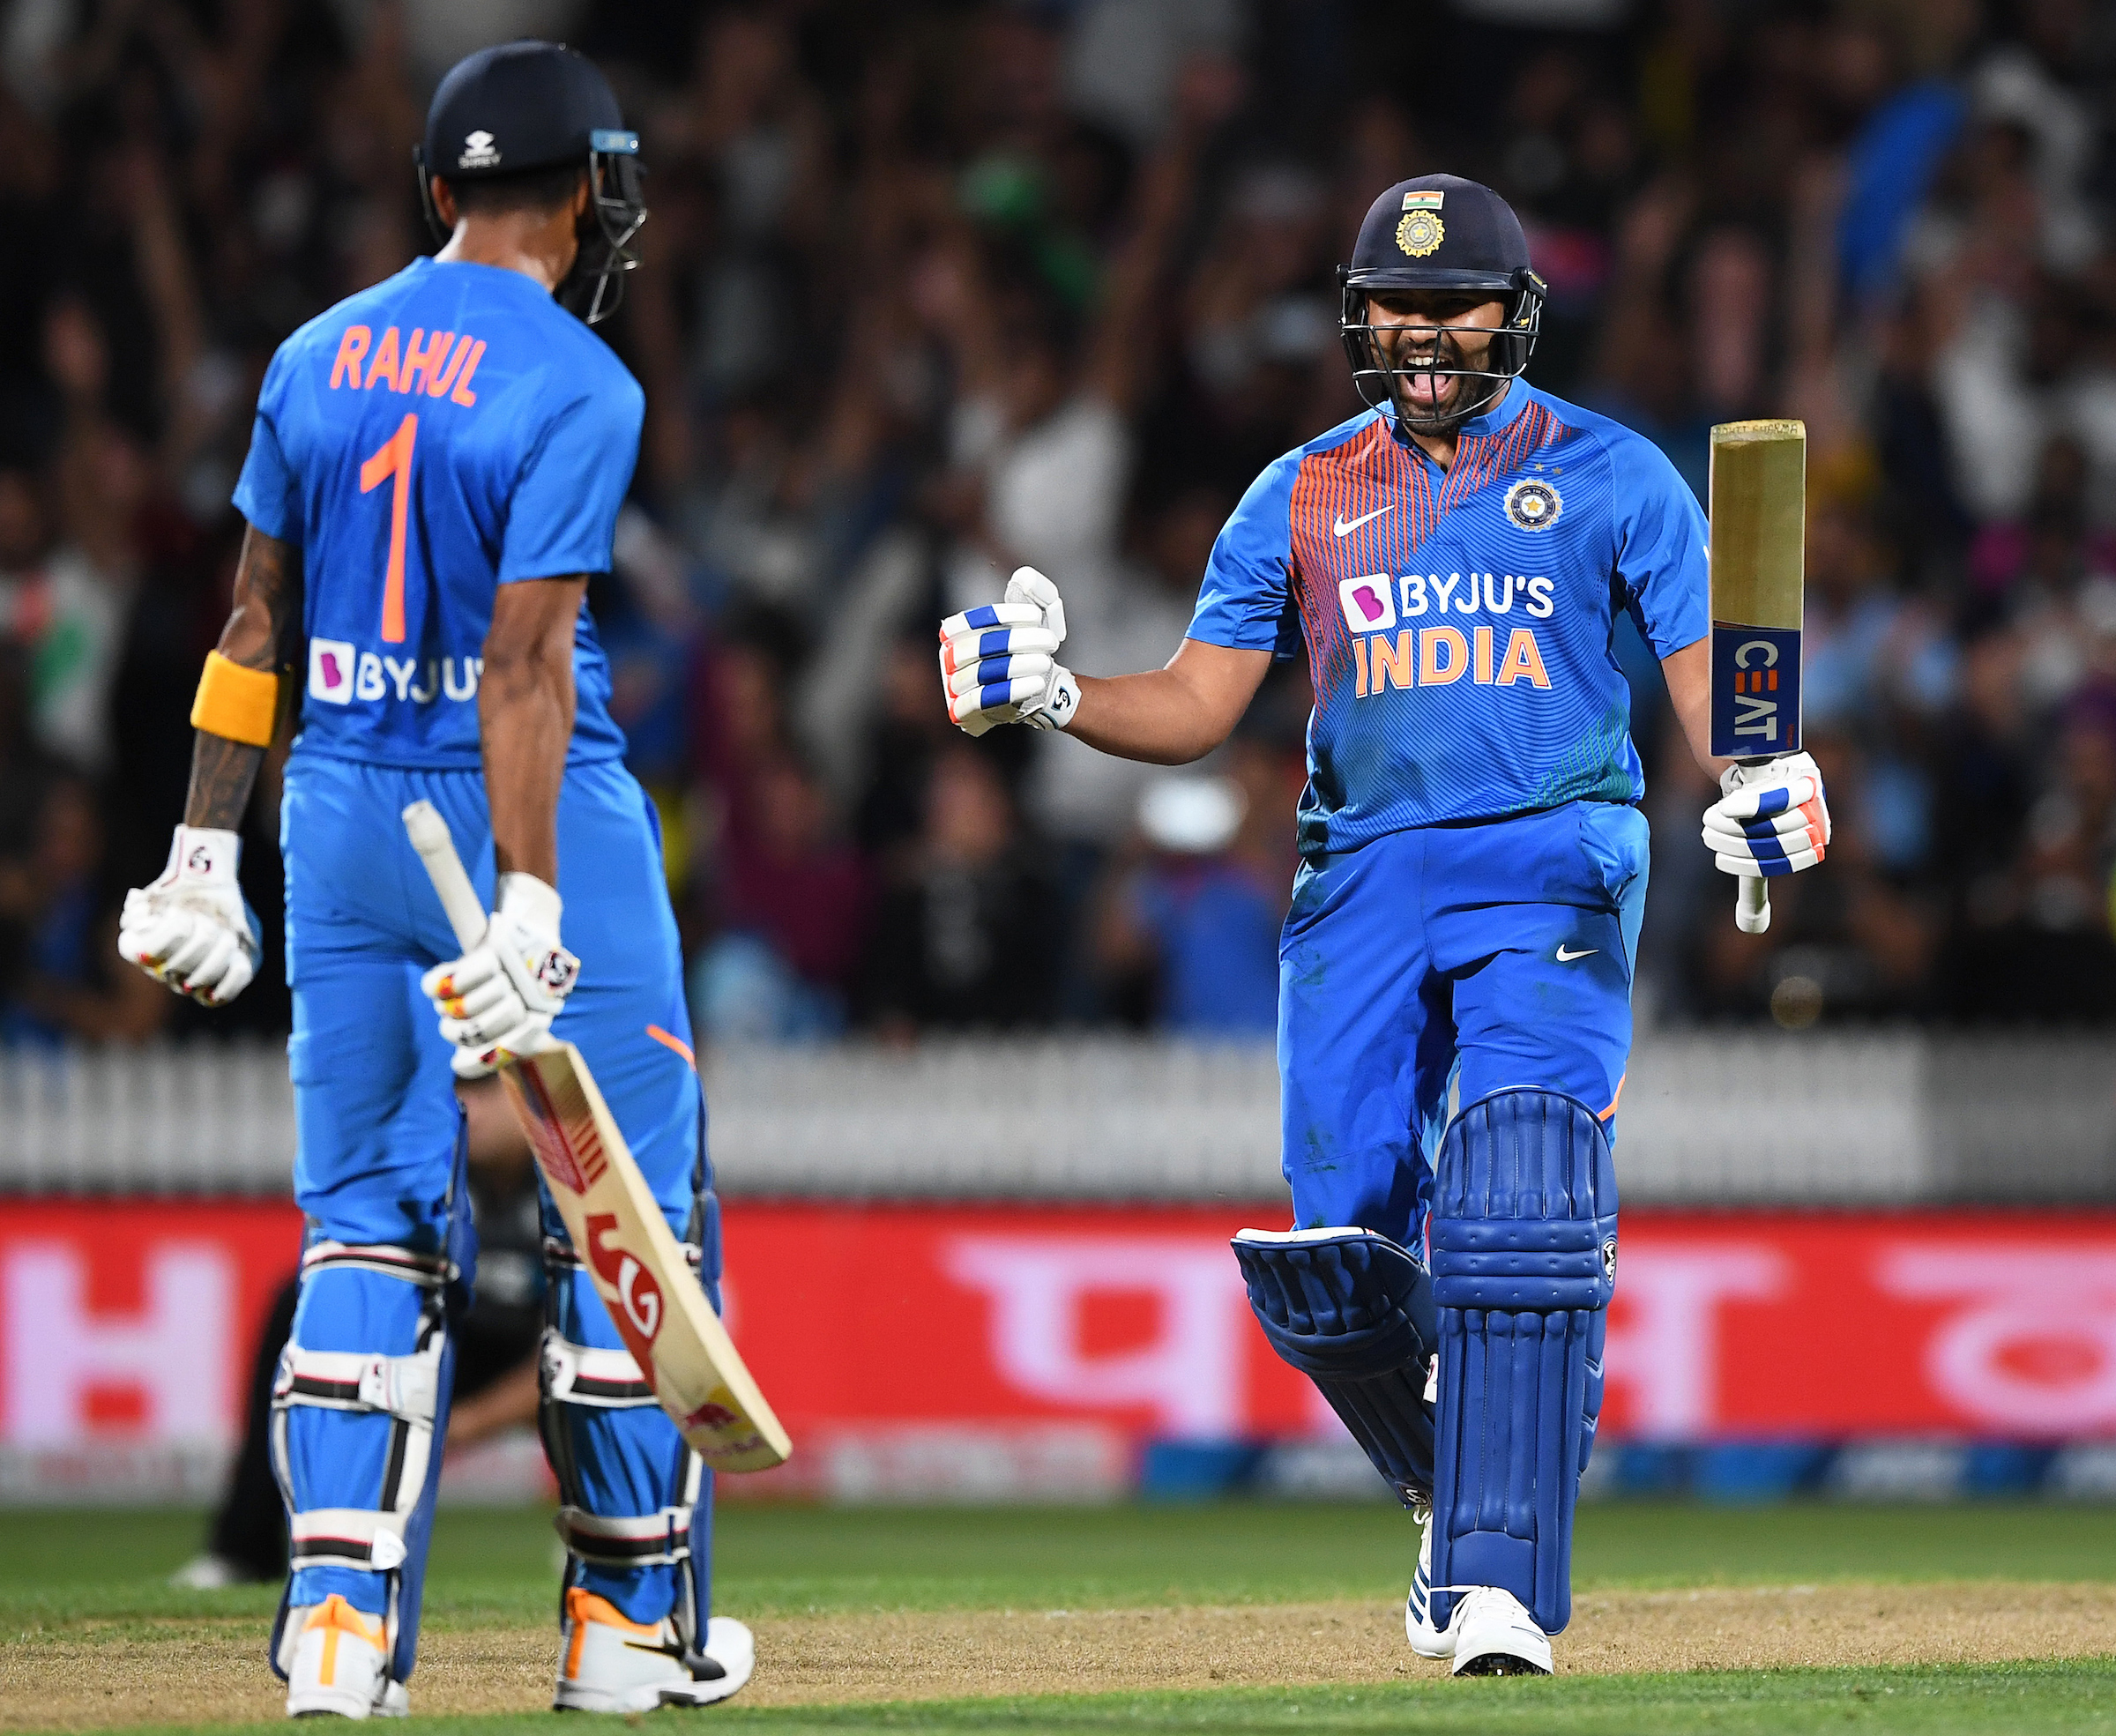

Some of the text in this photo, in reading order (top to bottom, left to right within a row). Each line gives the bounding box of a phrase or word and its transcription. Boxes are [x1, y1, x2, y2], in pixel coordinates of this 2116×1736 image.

[330, 324, 487, 408] RAHUL
[360, 413, 418, 644] 1
[1399, 572, 1554, 618] BYJU'S
[356, 651, 485, 704] BYJU'
[1352, 625, 1553, 699] INDIA
[1734, 640, 1778, 741] CEAT
